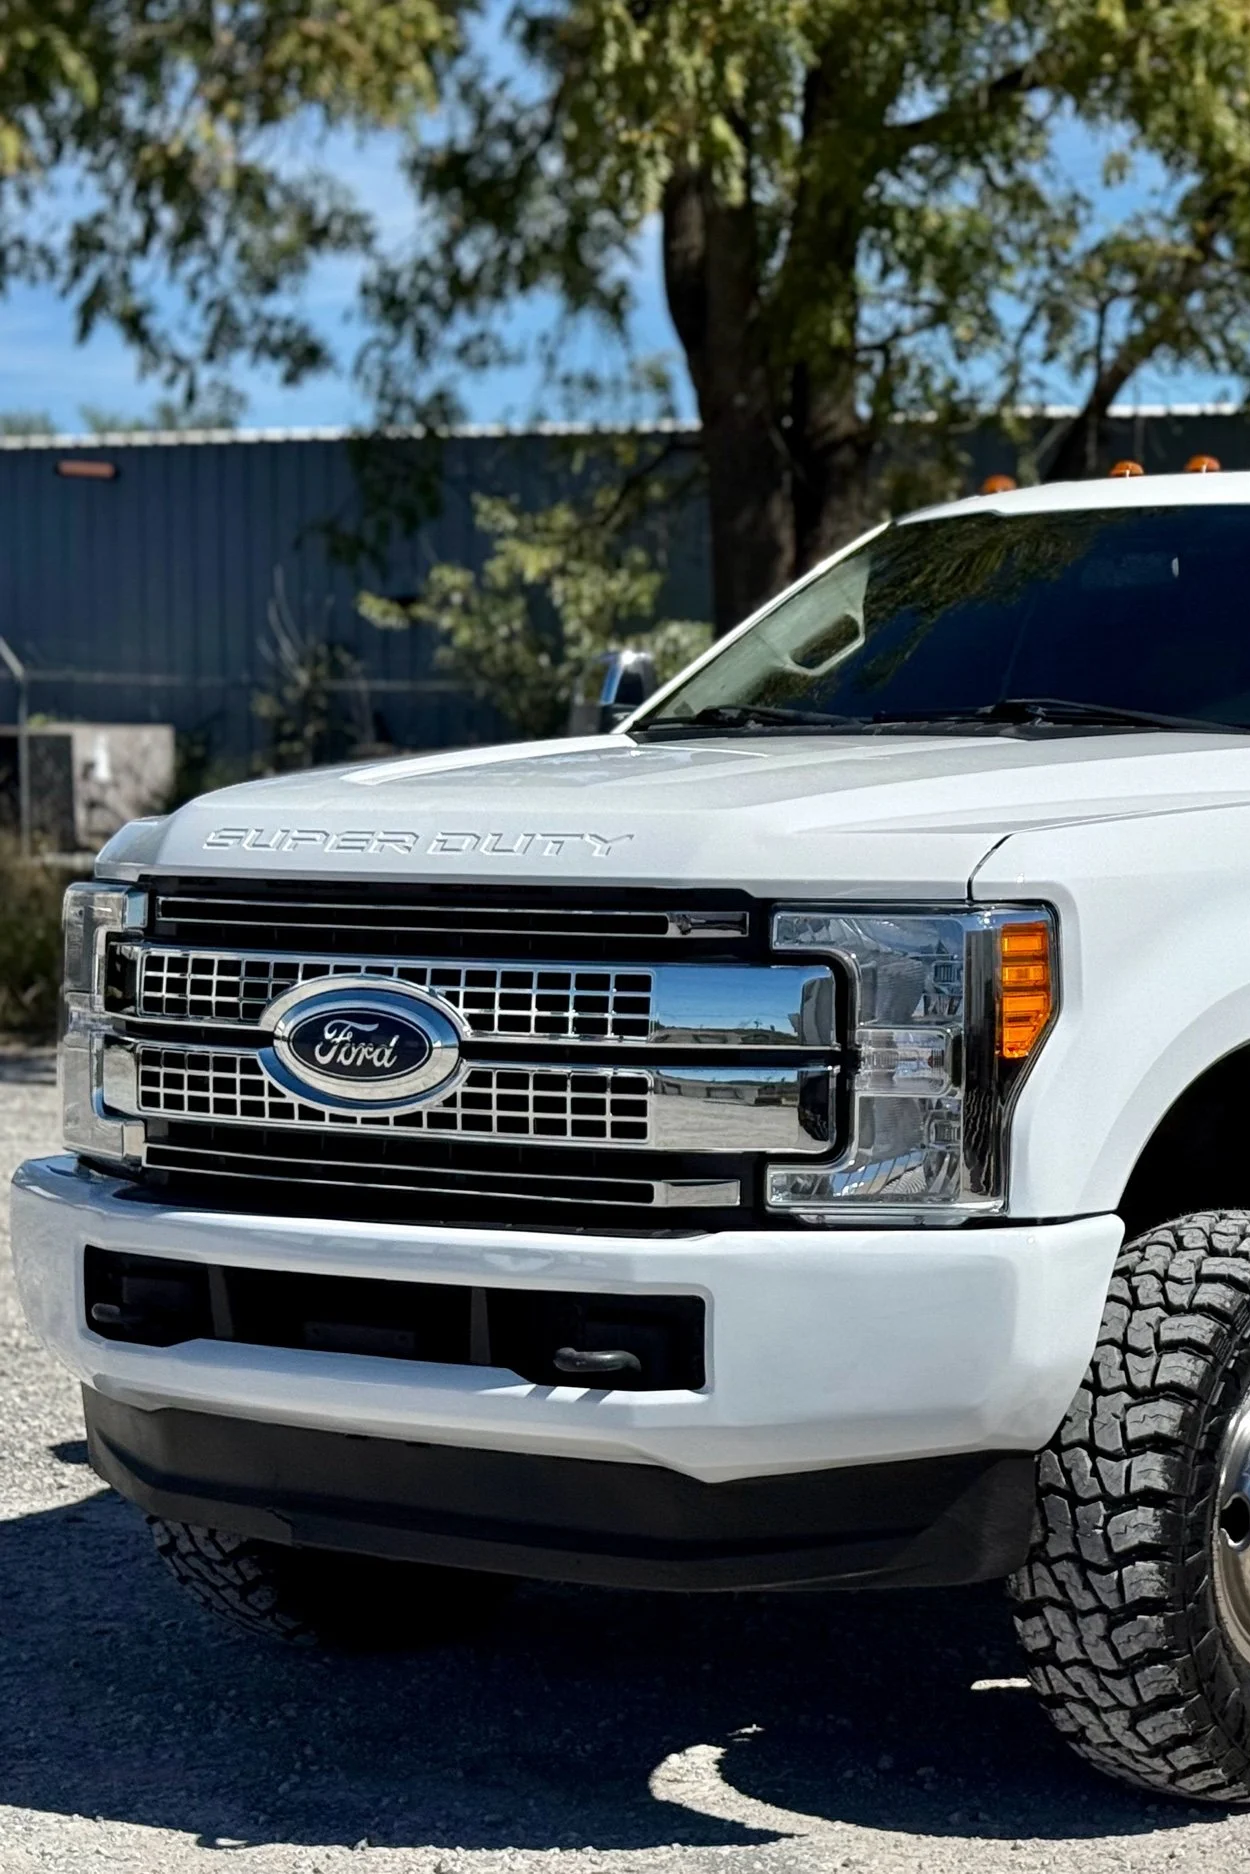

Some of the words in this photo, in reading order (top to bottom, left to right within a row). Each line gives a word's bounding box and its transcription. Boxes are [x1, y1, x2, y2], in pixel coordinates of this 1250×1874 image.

[202, 826, 422, 856] SUPER
[426, 831, 635, 858] DUTY
[314, 1018, 400, 1069] Ford
